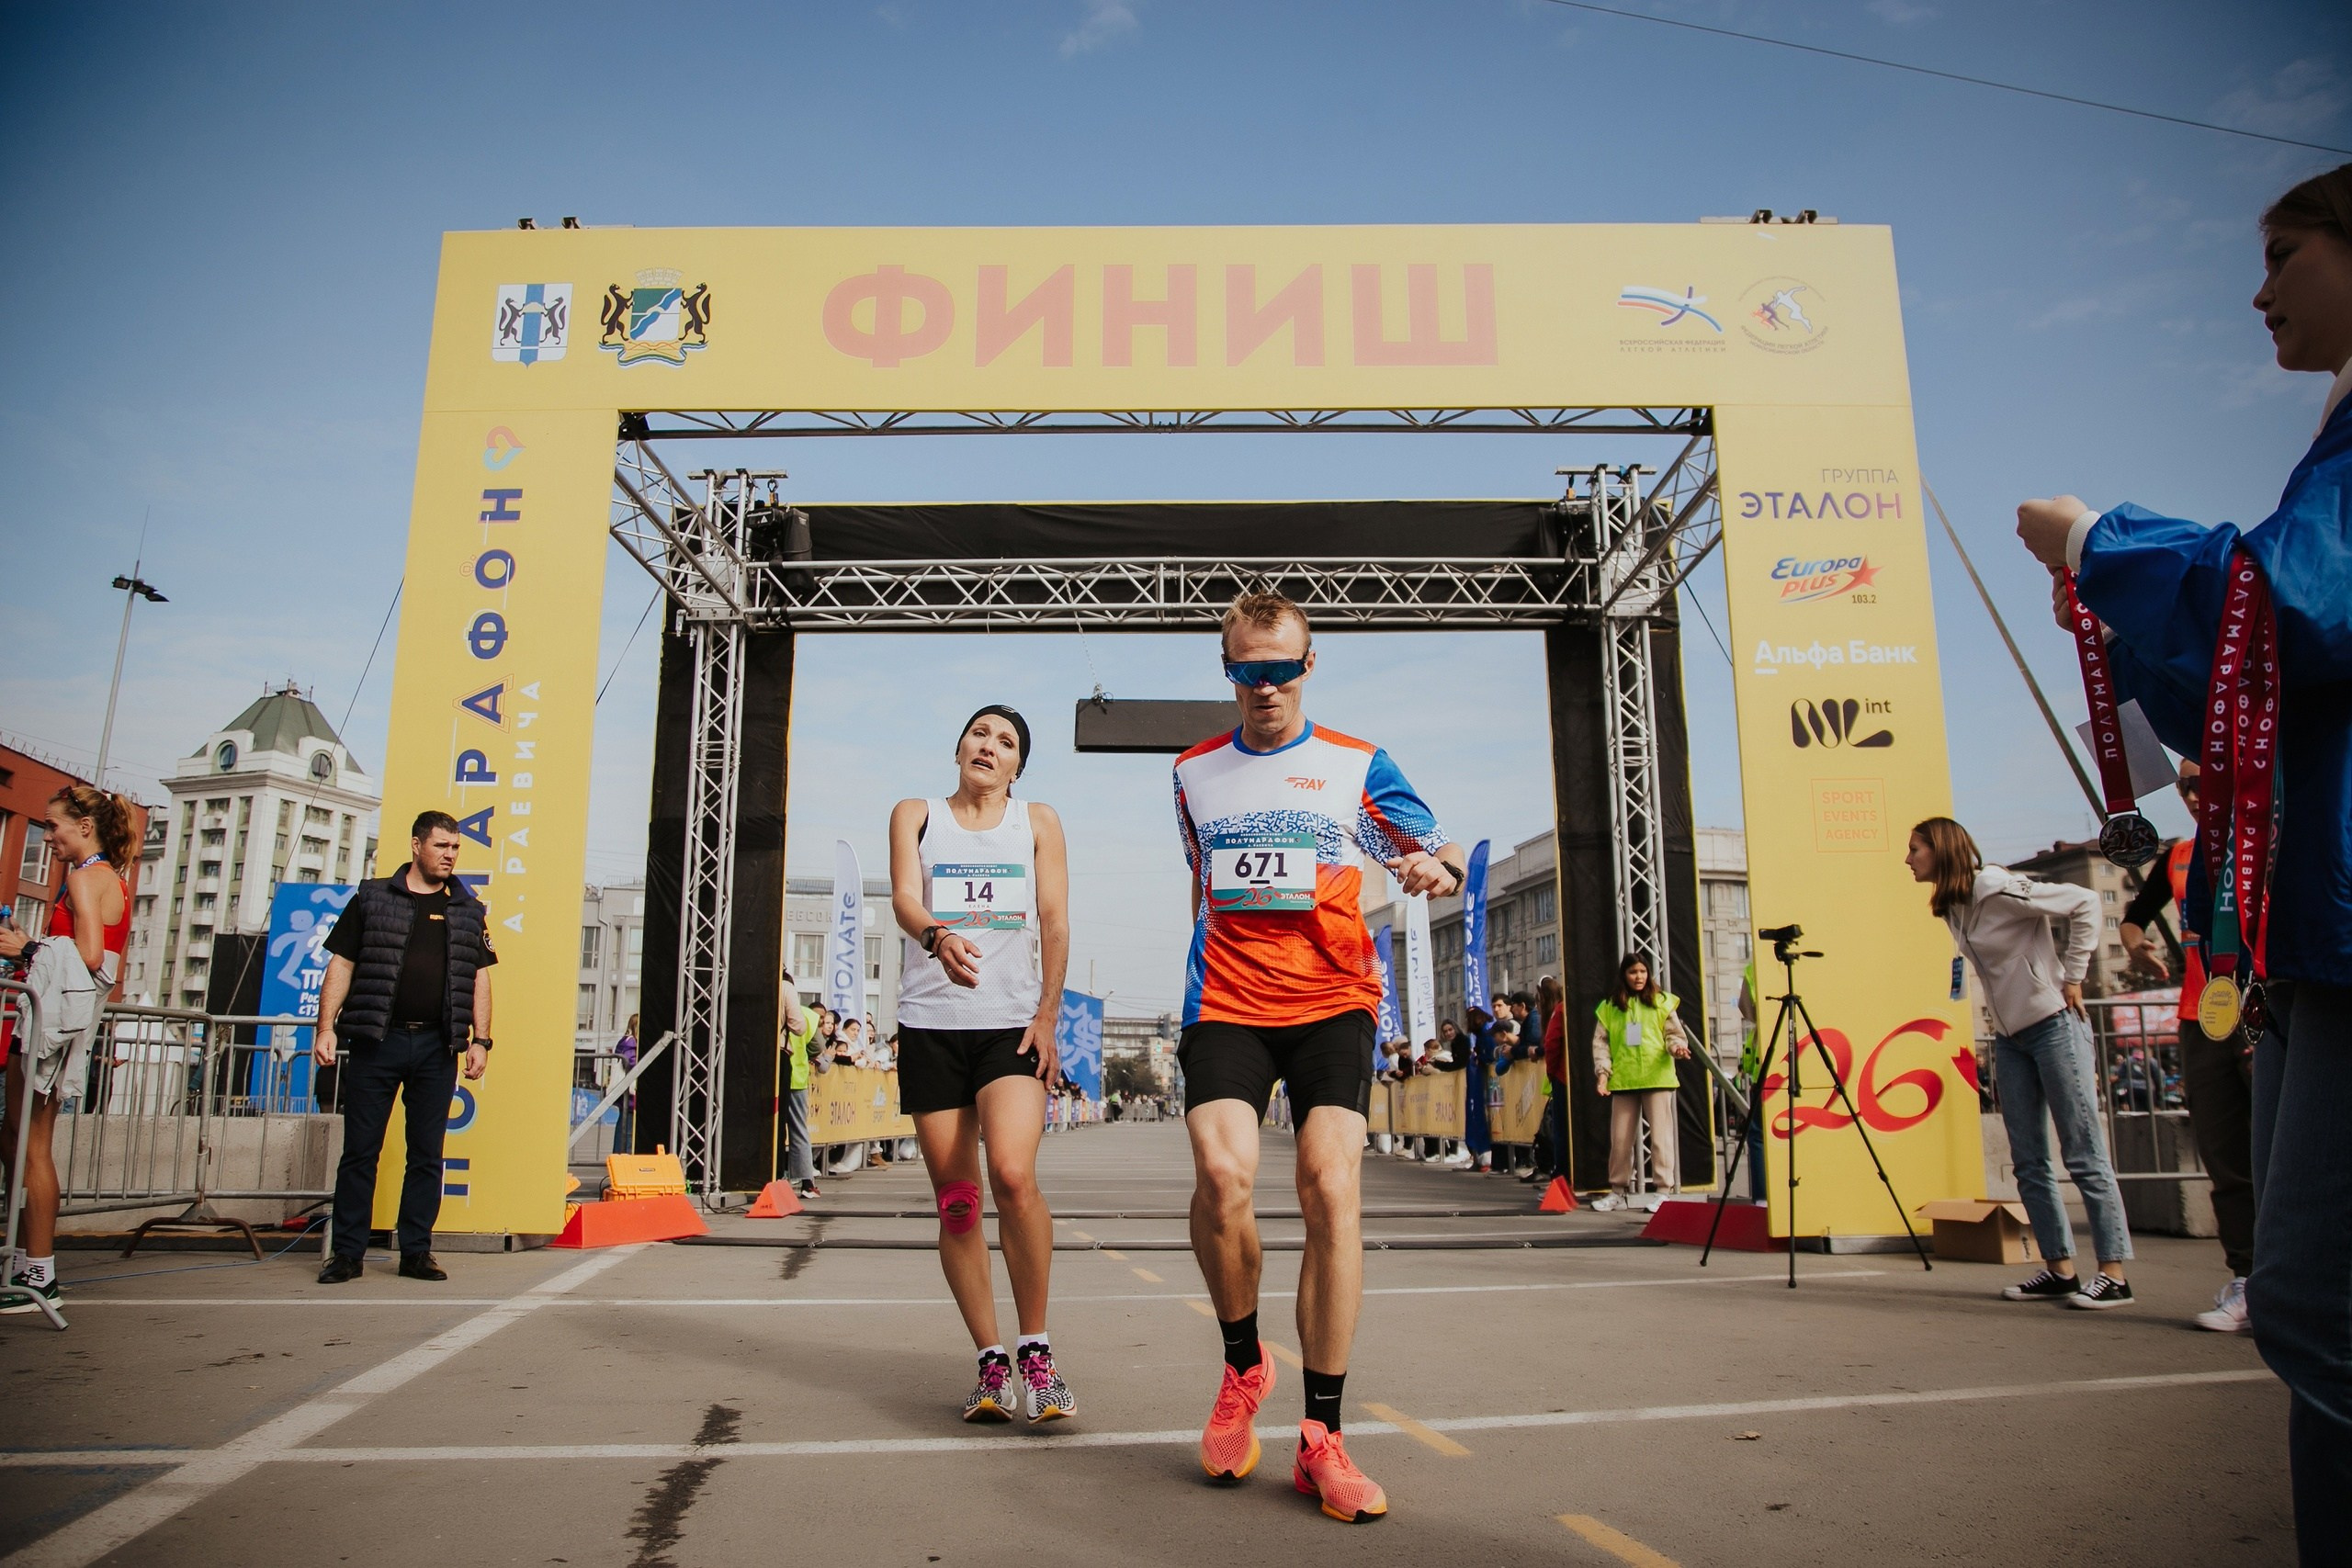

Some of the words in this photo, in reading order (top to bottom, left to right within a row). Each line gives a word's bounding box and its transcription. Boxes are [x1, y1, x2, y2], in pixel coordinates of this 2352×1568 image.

[821, 264, 1499, 368] ФИНИШ
[1822, 468, 1899, 483] ГРУППА
[1738, 491, 1902, 519] ЭТАЛОН
[1851, 595, 1877, 604] 103.2
[1754, 640, 1844, 671] Альфа
[1849, 639, 1918, 664] Банк
[2075, 602, 2119, 760] ПОЛУМАРАФО
[1865, 698, 1892, 714] int
[506, 681, 541, 874] РАЕВИЧА
[1284, 776, 1327, 791] RAY
[1822, 791, 1875, 805] SPORT
[1823, 810, 1877, 823] EVENTS
[1825, 829, 1878, 840] AGENCY
[1235, 852, 1287, 878] 671
[2242, 827, 2256, 919] РАЕВИЧА
[964, 881, 993, 902] 14
[1241, 886, 1275, 906] 26
[963, 909, 992, 927] 26
[1768, 1018, 1953, 1140] 26
